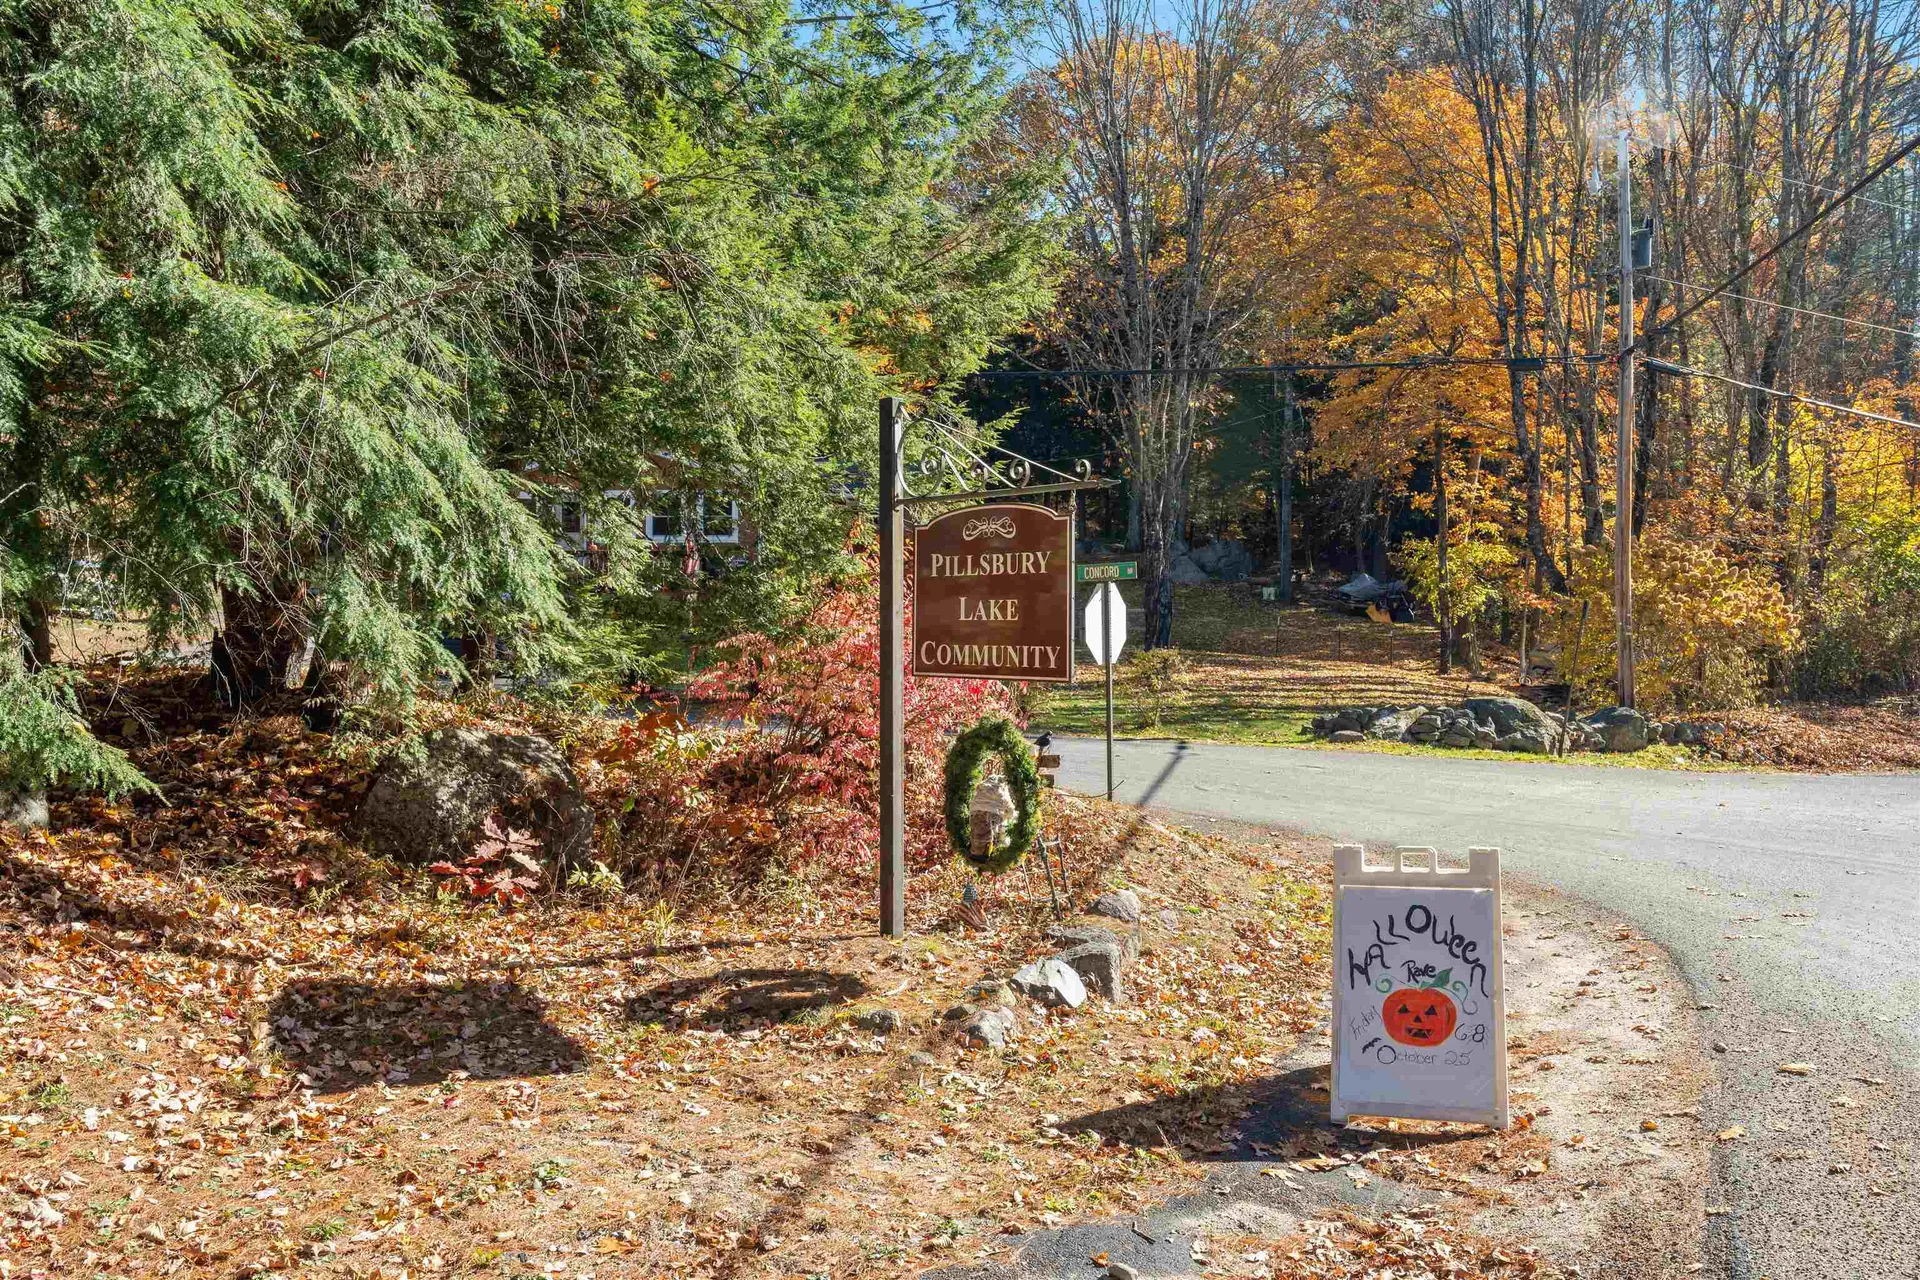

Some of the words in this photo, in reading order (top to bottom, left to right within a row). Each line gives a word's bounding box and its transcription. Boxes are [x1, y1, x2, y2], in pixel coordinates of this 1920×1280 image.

[931, 551, 1051, 577] PILLSBURY
[1084, 565, 1120, 580] CONCORD
[958, 596, 1020, 622] LAKE
[920, 640, 1061, 669] COMMUNITY
[1401, 959, 1437, 984] Rave
[1349, 1005, 1383, 1041] Friday
[1376, 1044, 1438, 1065] October
[1444, 1050, 1473, 1066] 25
